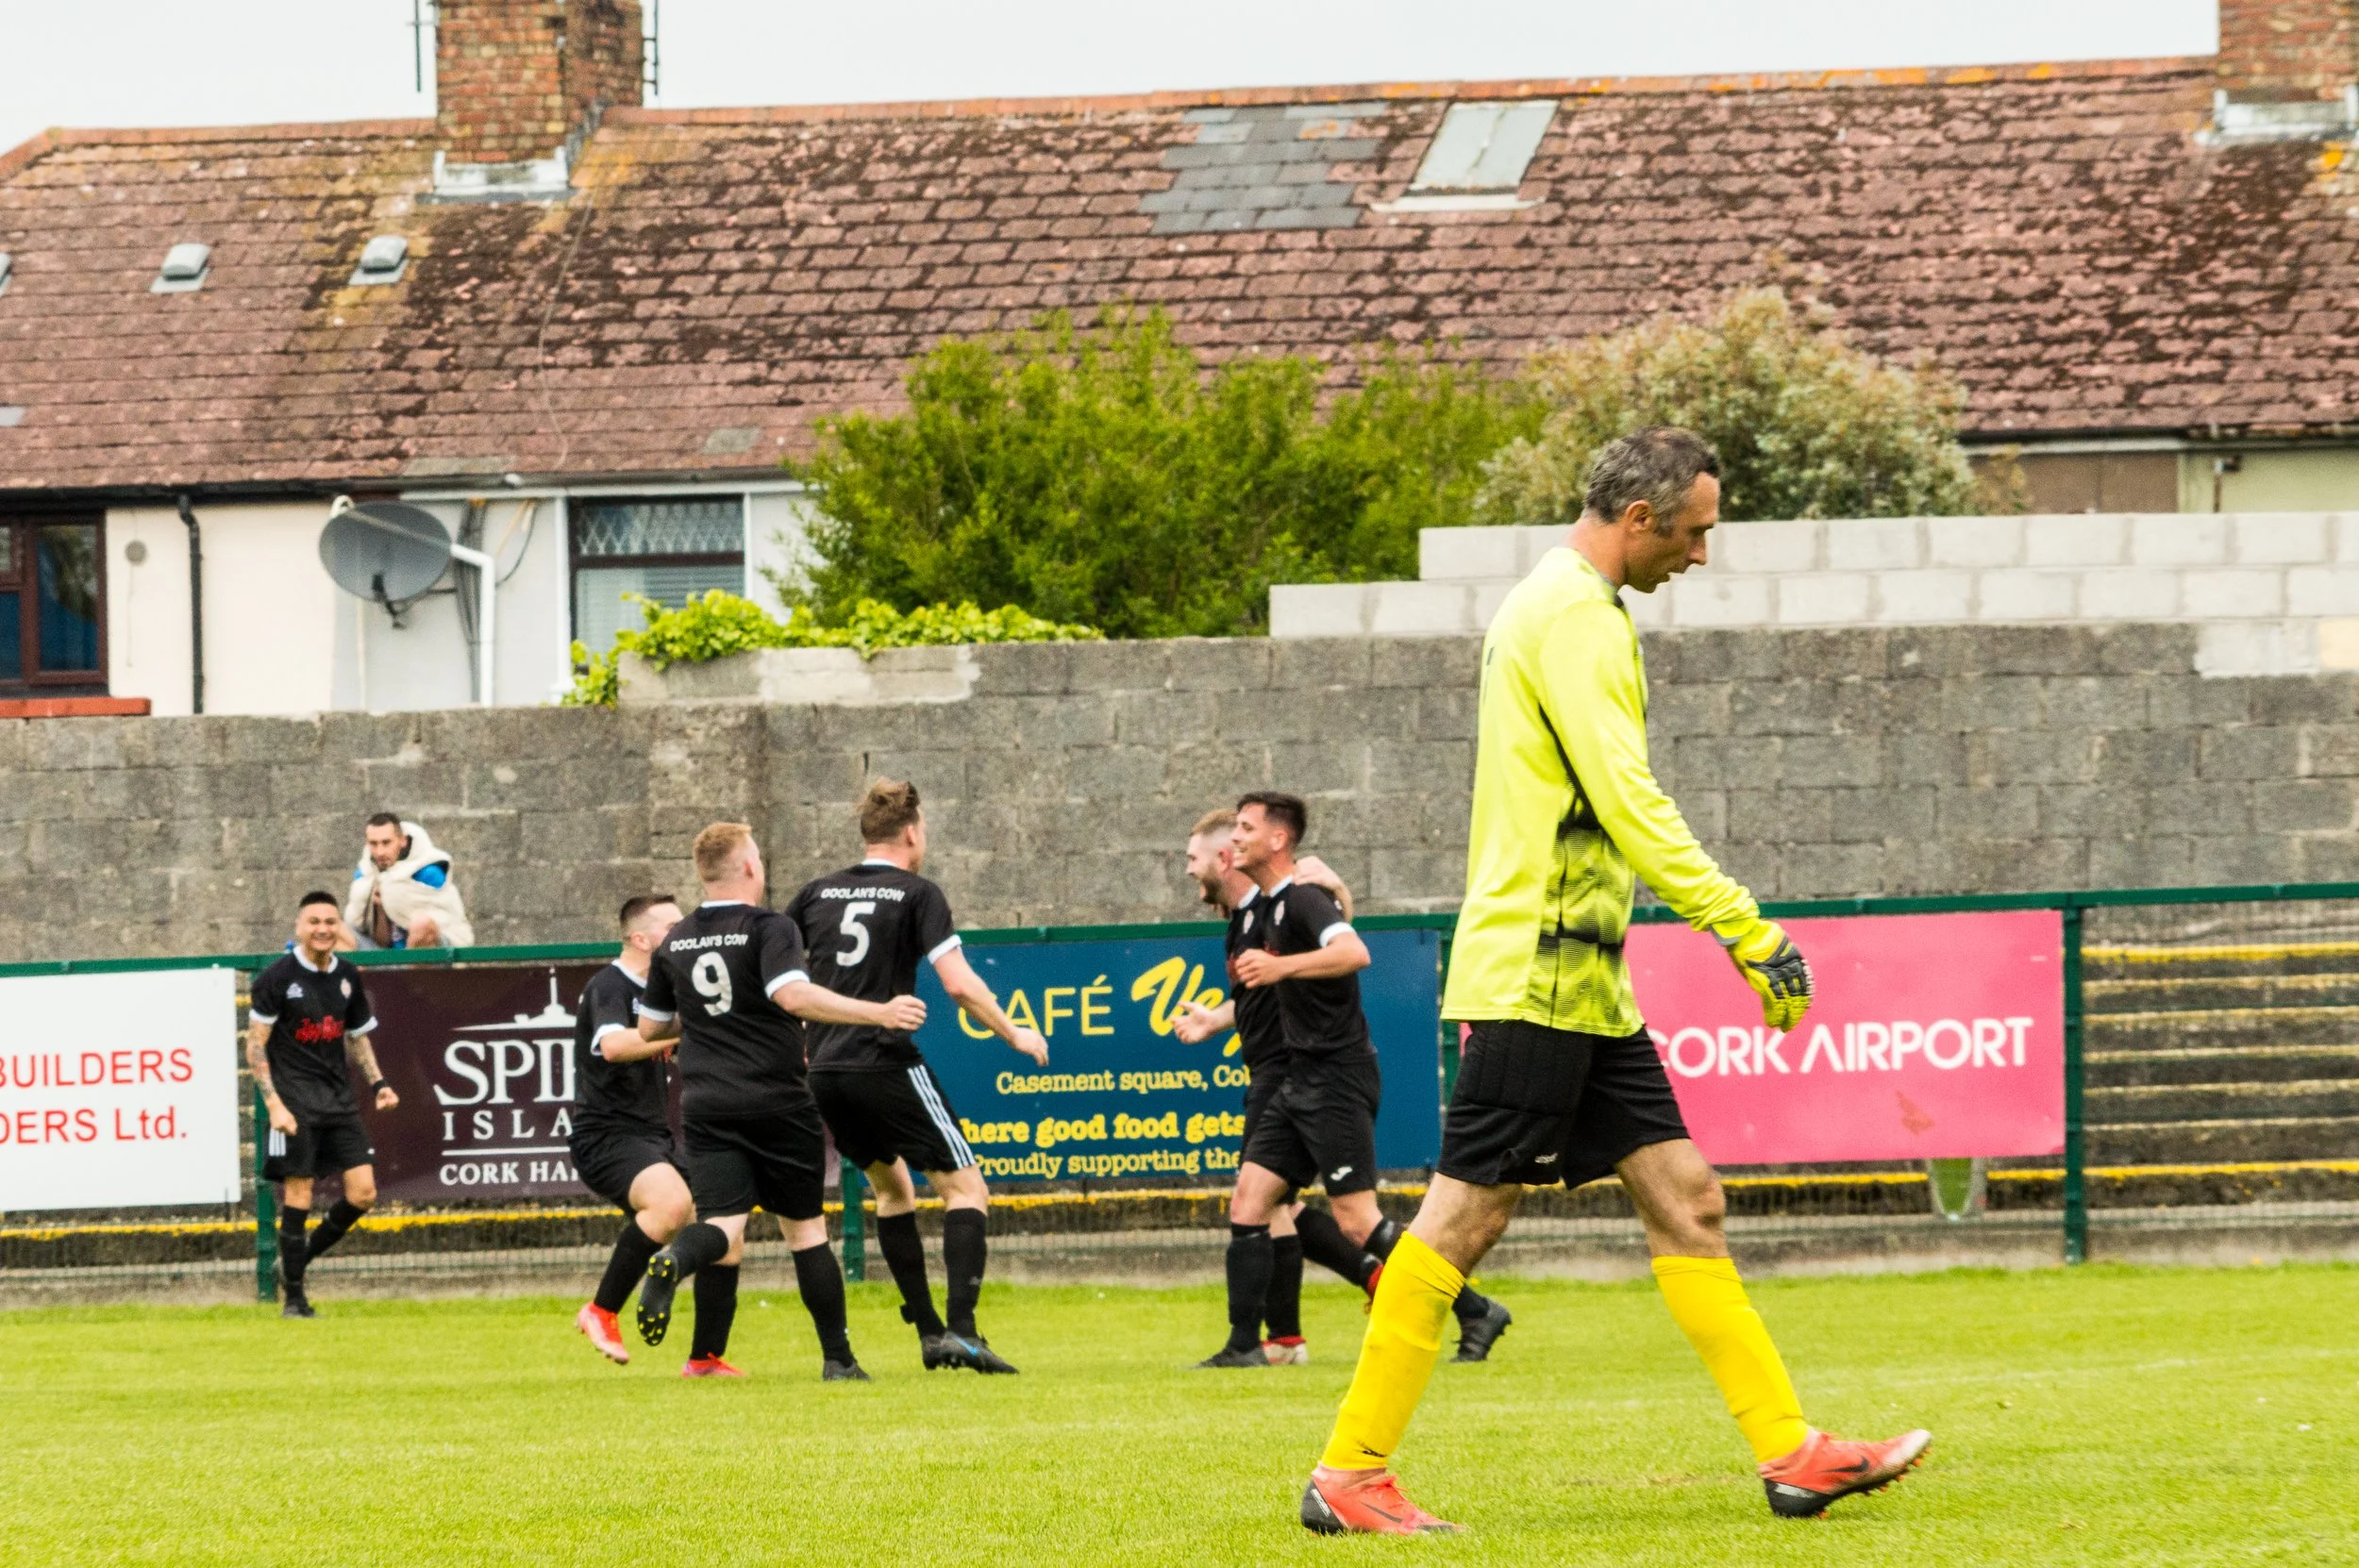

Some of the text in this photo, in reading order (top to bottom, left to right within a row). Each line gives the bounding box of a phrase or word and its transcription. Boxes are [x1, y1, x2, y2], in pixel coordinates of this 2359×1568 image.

[877, 887, 906, 902] COW
[836, 901, 877, 967] 5
[691, 951, 732, 1016] 9
[1799, 1016, 2033, 1074] AIRPORT
[996, 1069, 1115, 1094] Casement
[1119, 1068, 1209, 1094] square,
[114, 1106, 188, 1142] Ltd.
[1035, 1113, 1107, 1148] good
[1113, 1111, 1180, 1140] food
[1185, 1110, 1246, 1143] gets
[440, 1161, 520, 1186] CORK
[1068, 1149, 1200, 1176] supporting
